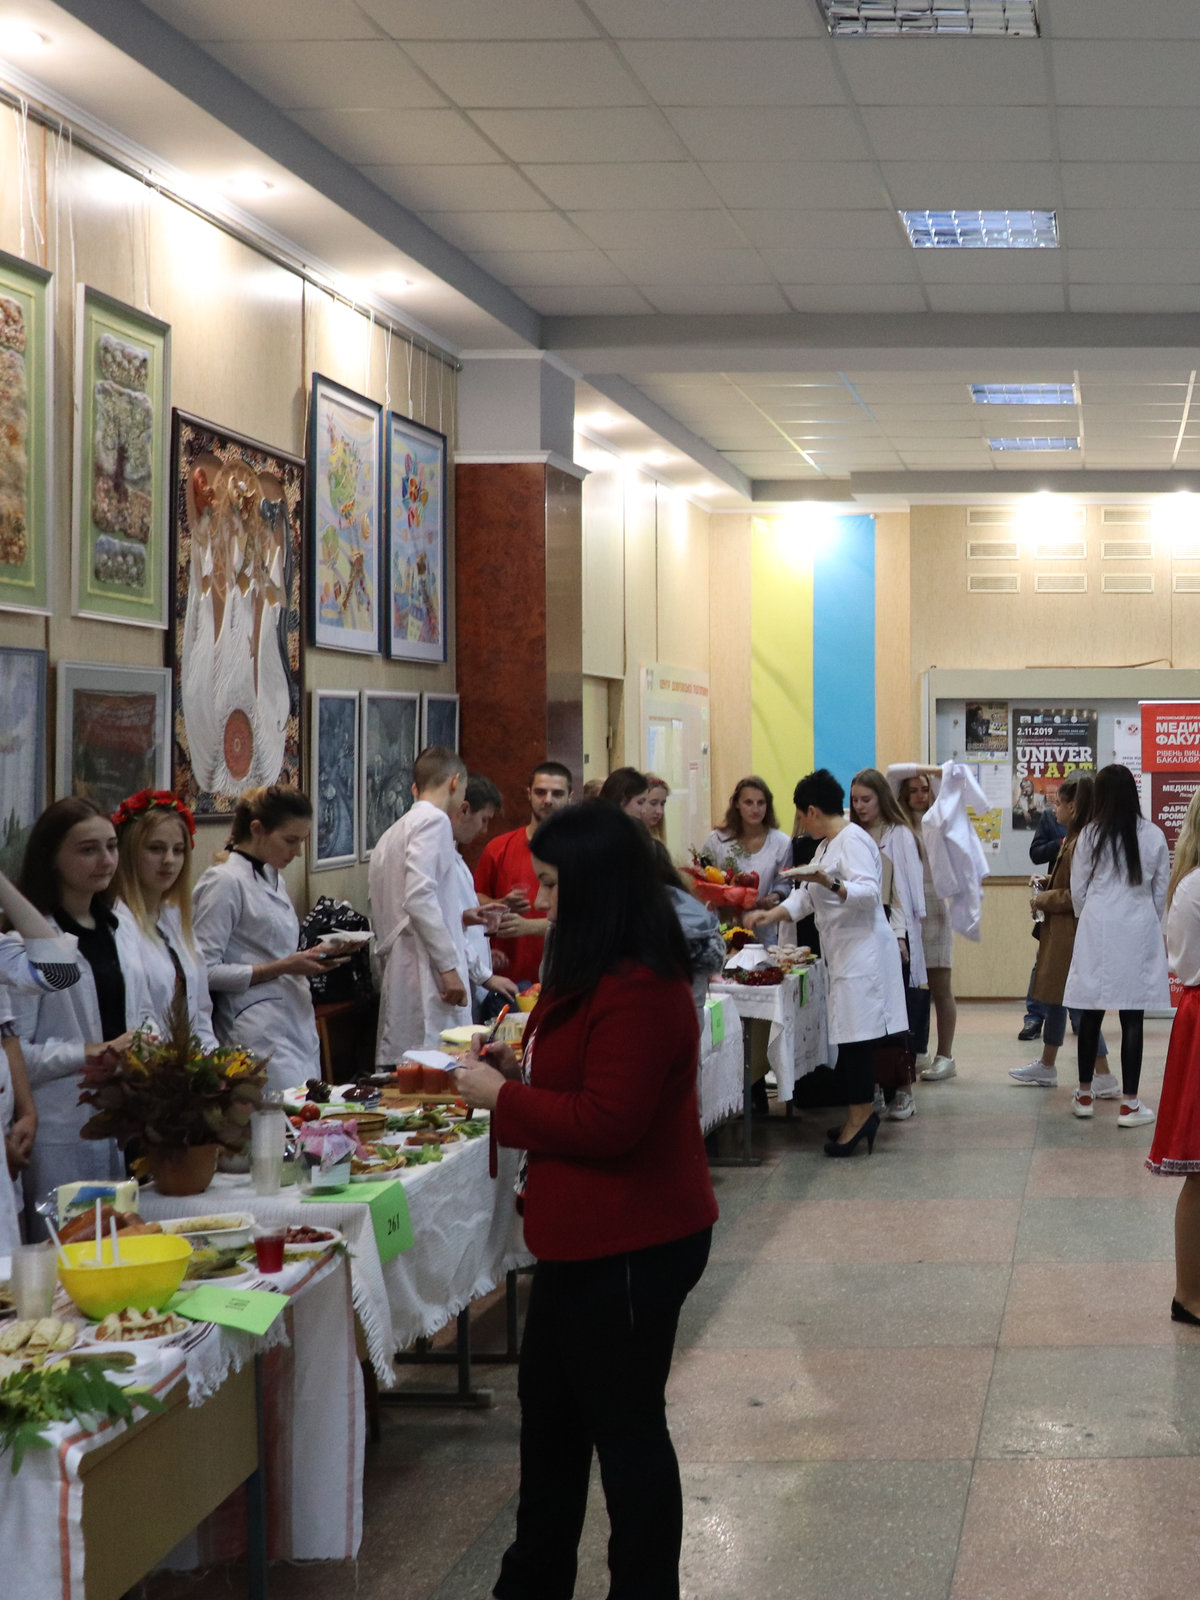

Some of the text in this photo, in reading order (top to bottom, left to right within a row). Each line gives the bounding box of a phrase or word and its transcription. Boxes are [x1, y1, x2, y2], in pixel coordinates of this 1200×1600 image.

[1016, 747, 1092, 761] UNIVER
[1162, 784, 1200, 792] МЕДИЦИ
[387, 1213, 400, 1236] 261
